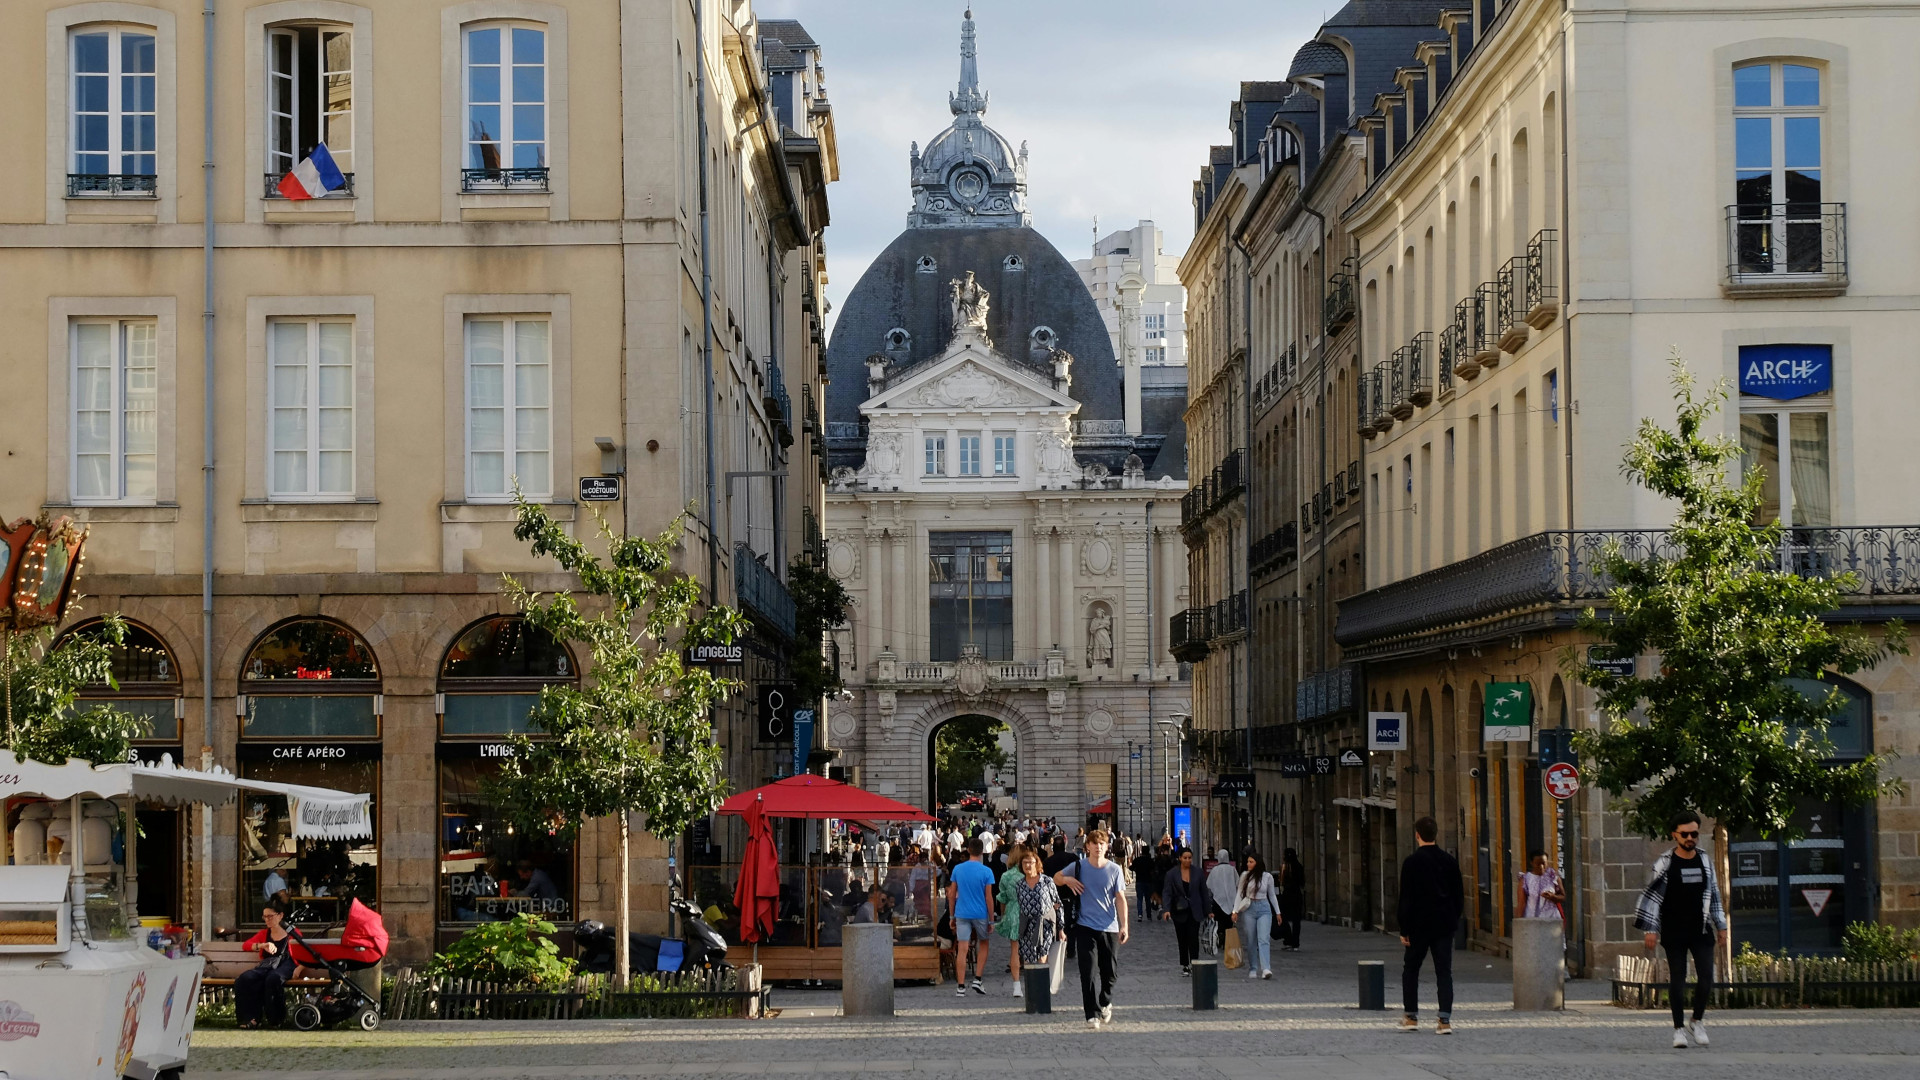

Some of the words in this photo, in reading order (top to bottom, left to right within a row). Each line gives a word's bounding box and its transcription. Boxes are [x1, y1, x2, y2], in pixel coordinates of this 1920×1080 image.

[273, 746, 303, 758] CAFÉ
[307, 746, 346, 758] APÉRO
[450, 875, 495, 896] BAR
[0, 1021, 38, 1035] Cream
